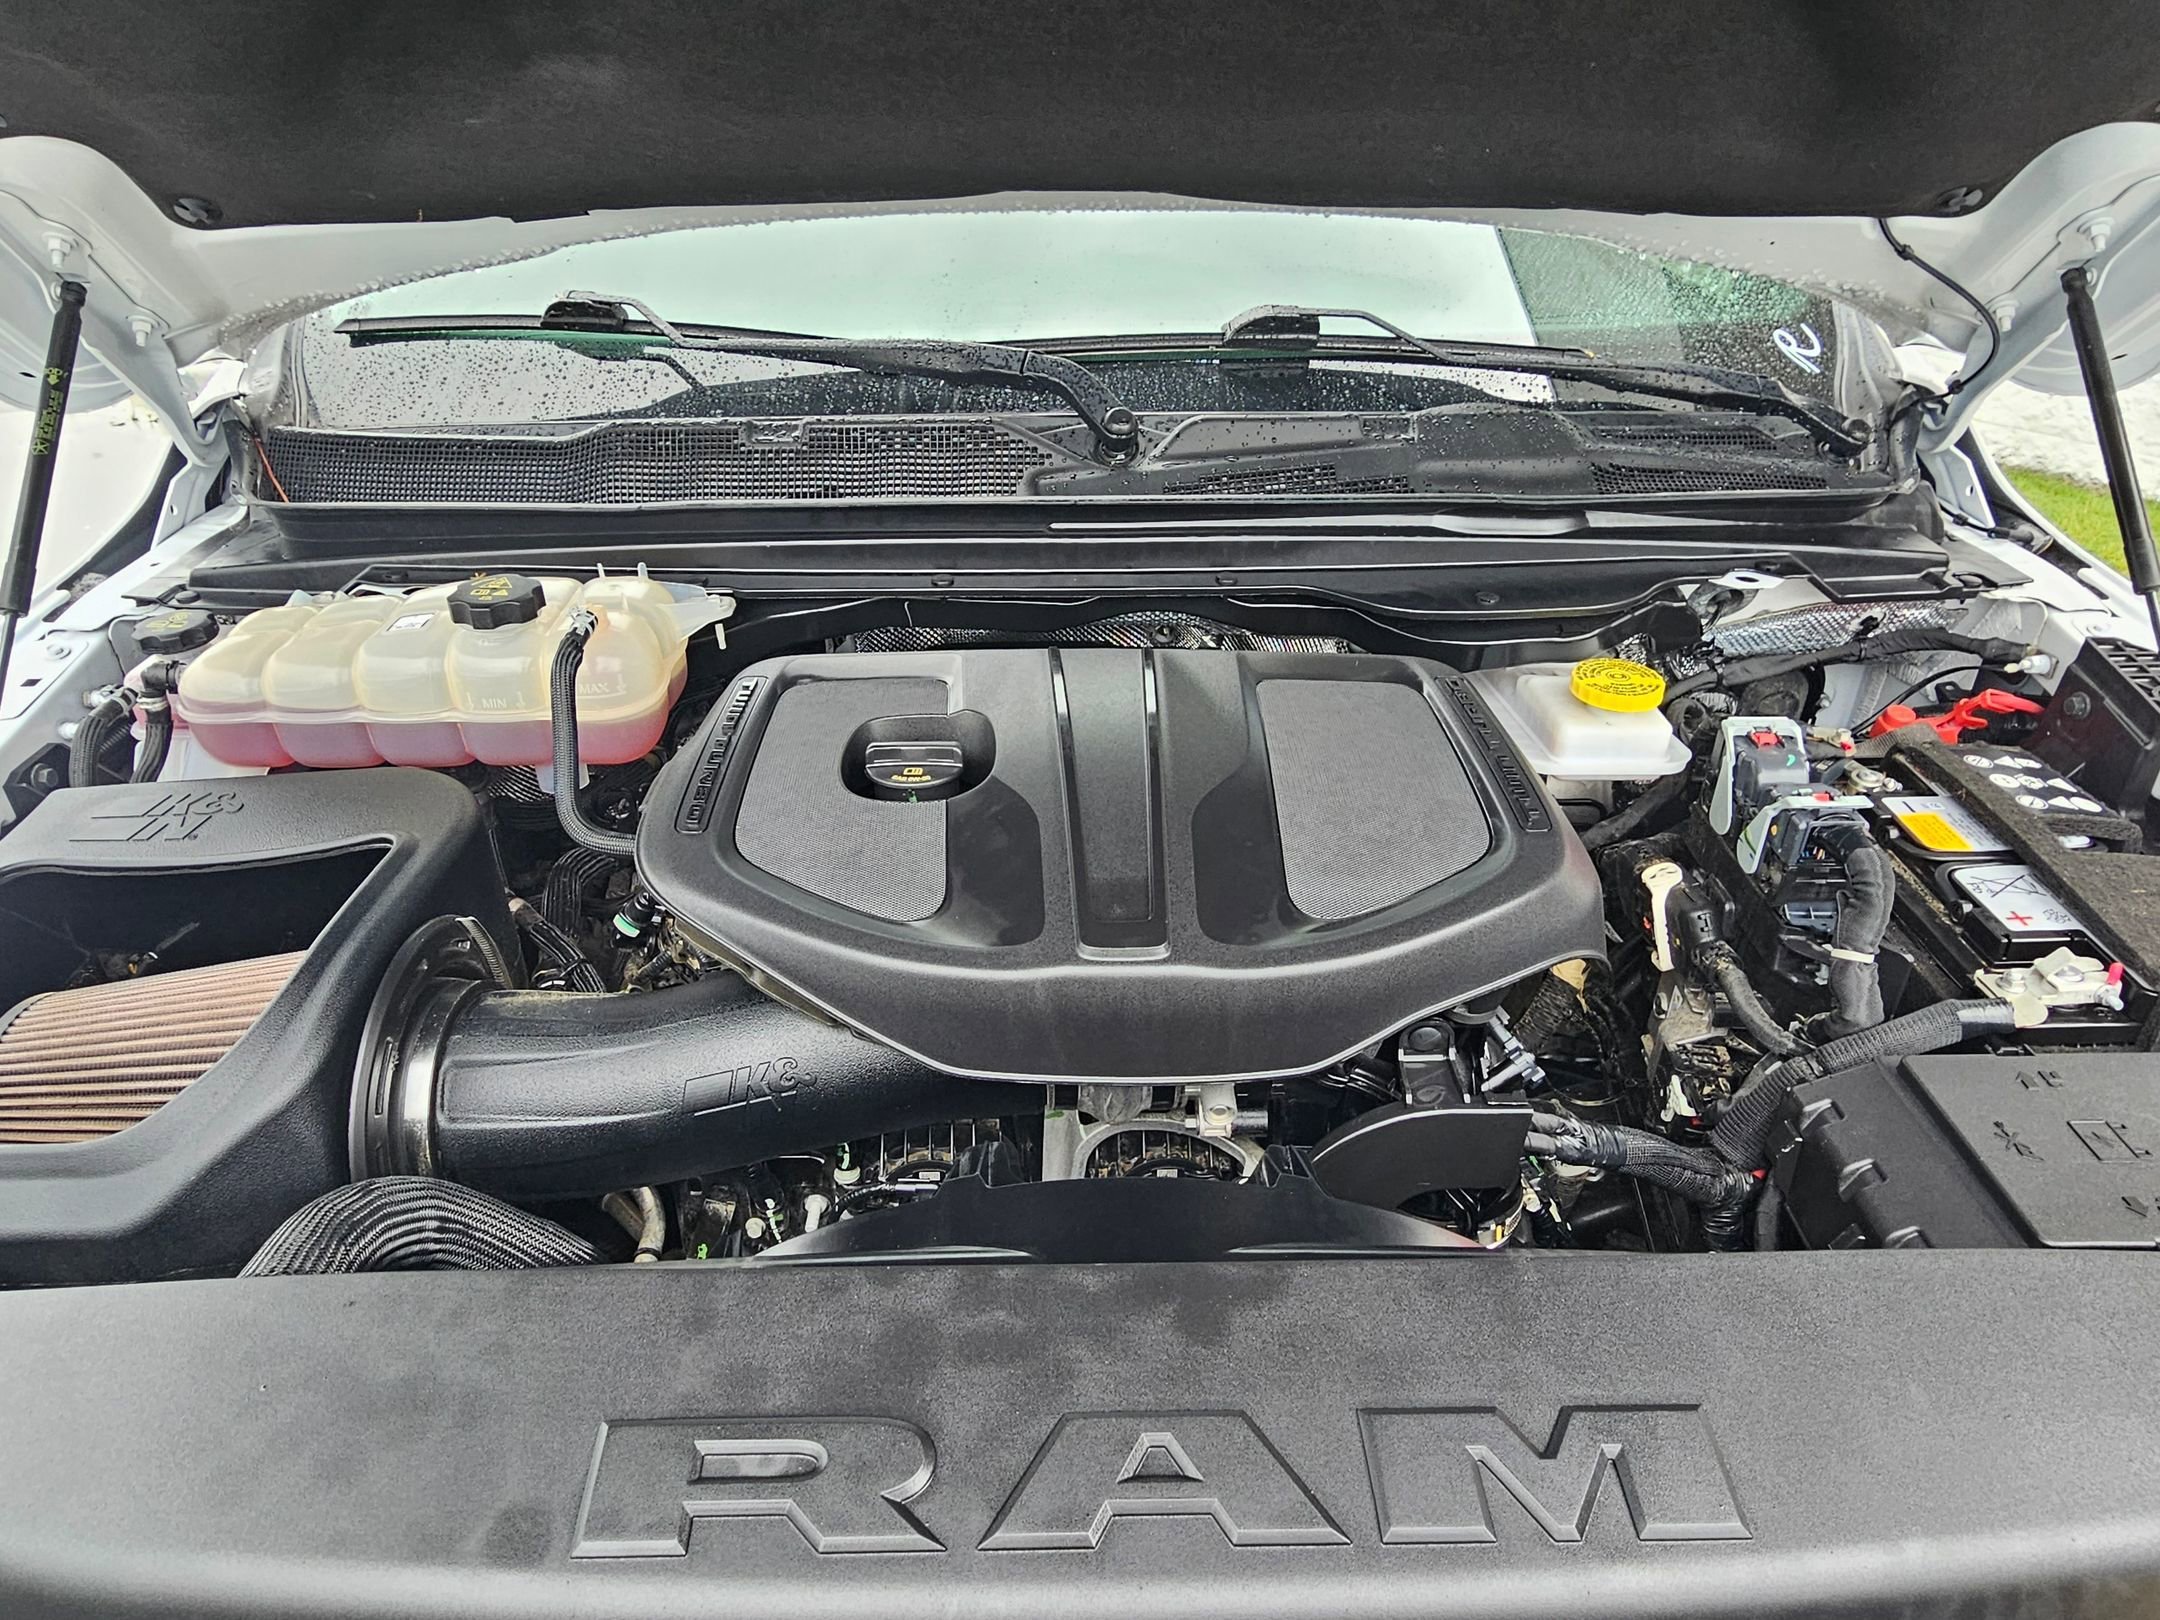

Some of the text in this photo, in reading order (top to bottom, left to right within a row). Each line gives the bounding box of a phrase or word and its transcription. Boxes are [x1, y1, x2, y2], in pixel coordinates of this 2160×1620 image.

[482, 697, 508, 710] MIN
[578, 682, 609, 695] MAX
[1445, 677, 1501, 752] TURBO
[685, 734, 732, 829] TURBO
[570, 1404, 1753, 1559] RAM
